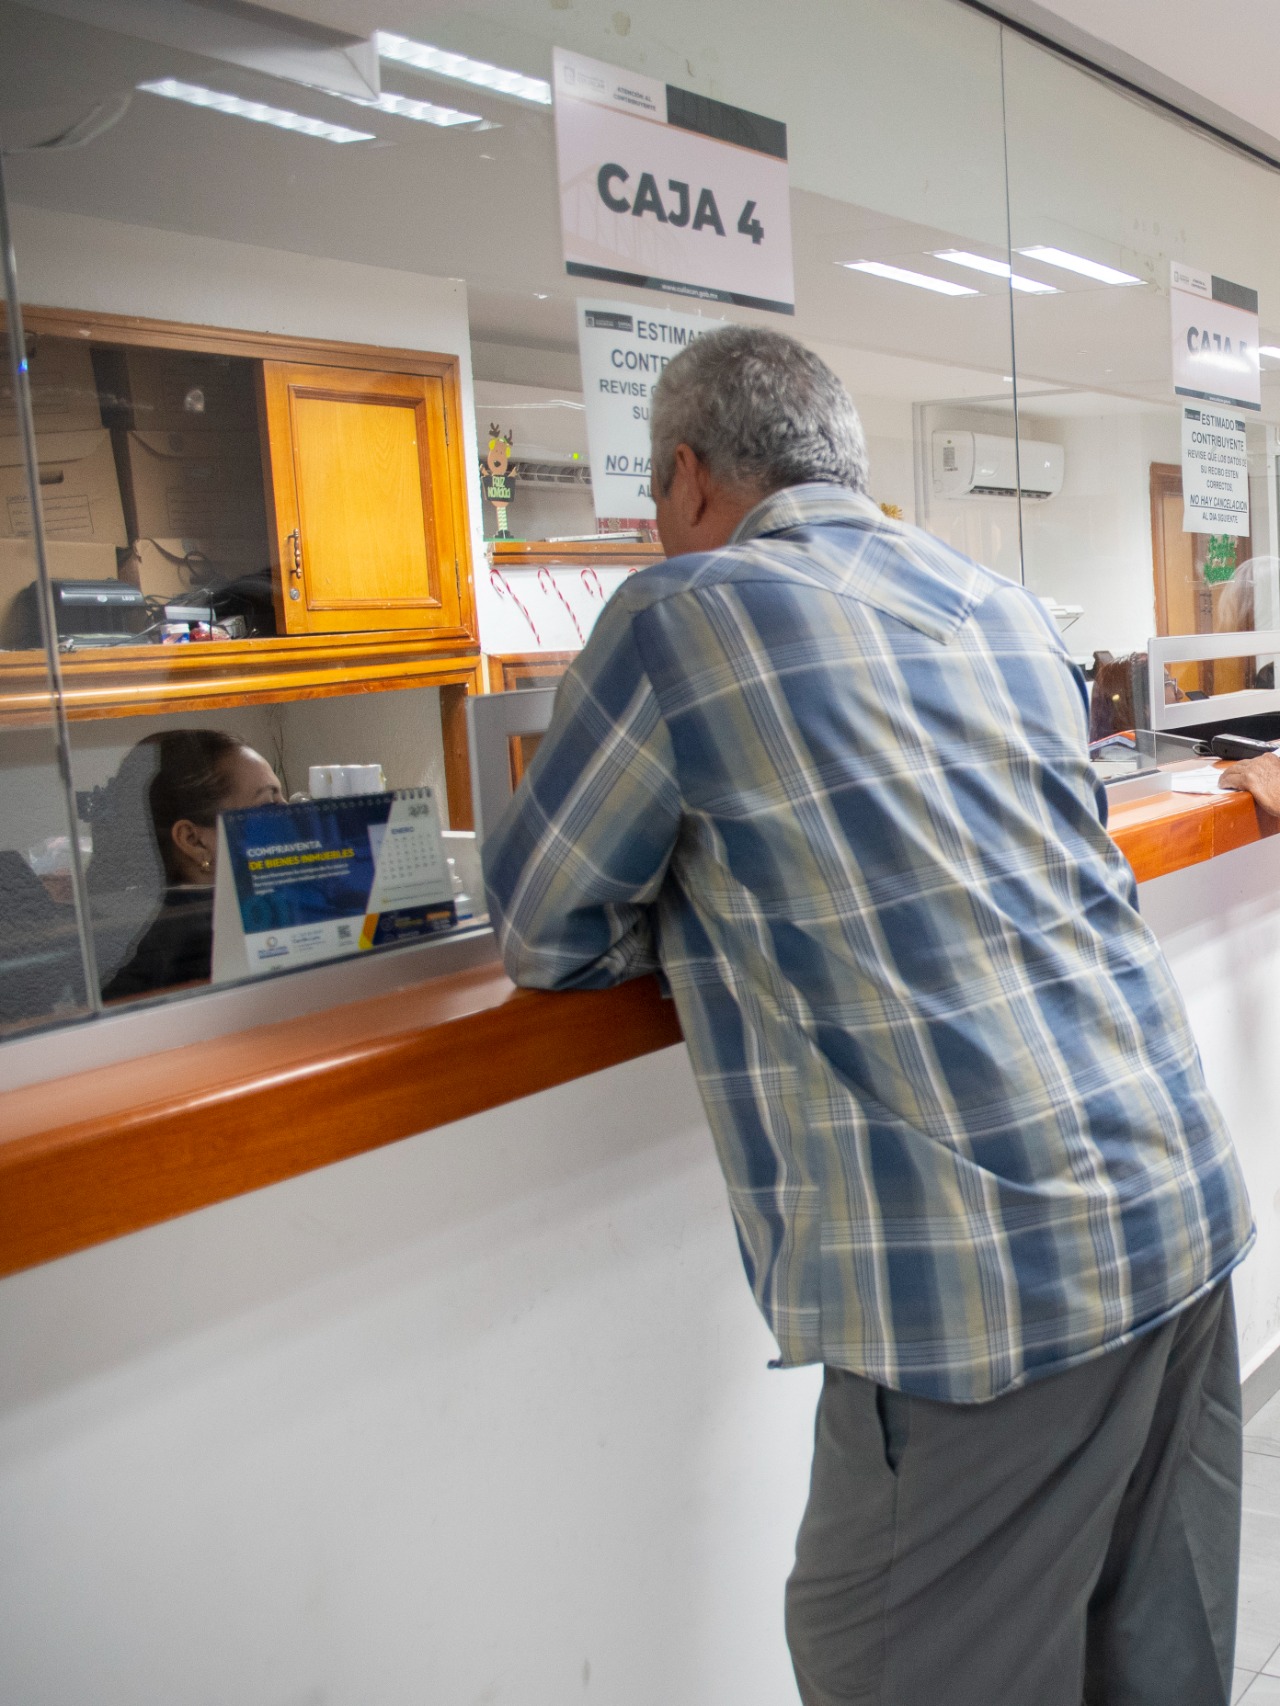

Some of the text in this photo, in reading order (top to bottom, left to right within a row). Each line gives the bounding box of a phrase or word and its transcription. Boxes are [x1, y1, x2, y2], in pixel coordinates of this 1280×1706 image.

[597, 162, 765, 245] CAJA 4
[637, 320, 704, 346] ESTIMA
[599, 378, 648, 398] REVISE
[633, 405, 650, 421] SU
[1201, 413, 1235, 431] ESTIMADO
[1191, 431, 1244, 452] CONTRIBUYENTE
[605, 454, 629, 472] NO
[1187, 449, 1207, 460] REVISE
[1207, 452, 1218, 462] QUE
[1208, 465, 1225, 477] RECIBO
[1190, 494, 1200, 505] NO
[1200, 496, 1213, 506] HAY
[246, 841, 322, 858] COMPRAVENTA
[248, 860, 264, 871] DE
[264, 855, 300, 869] BIENES
